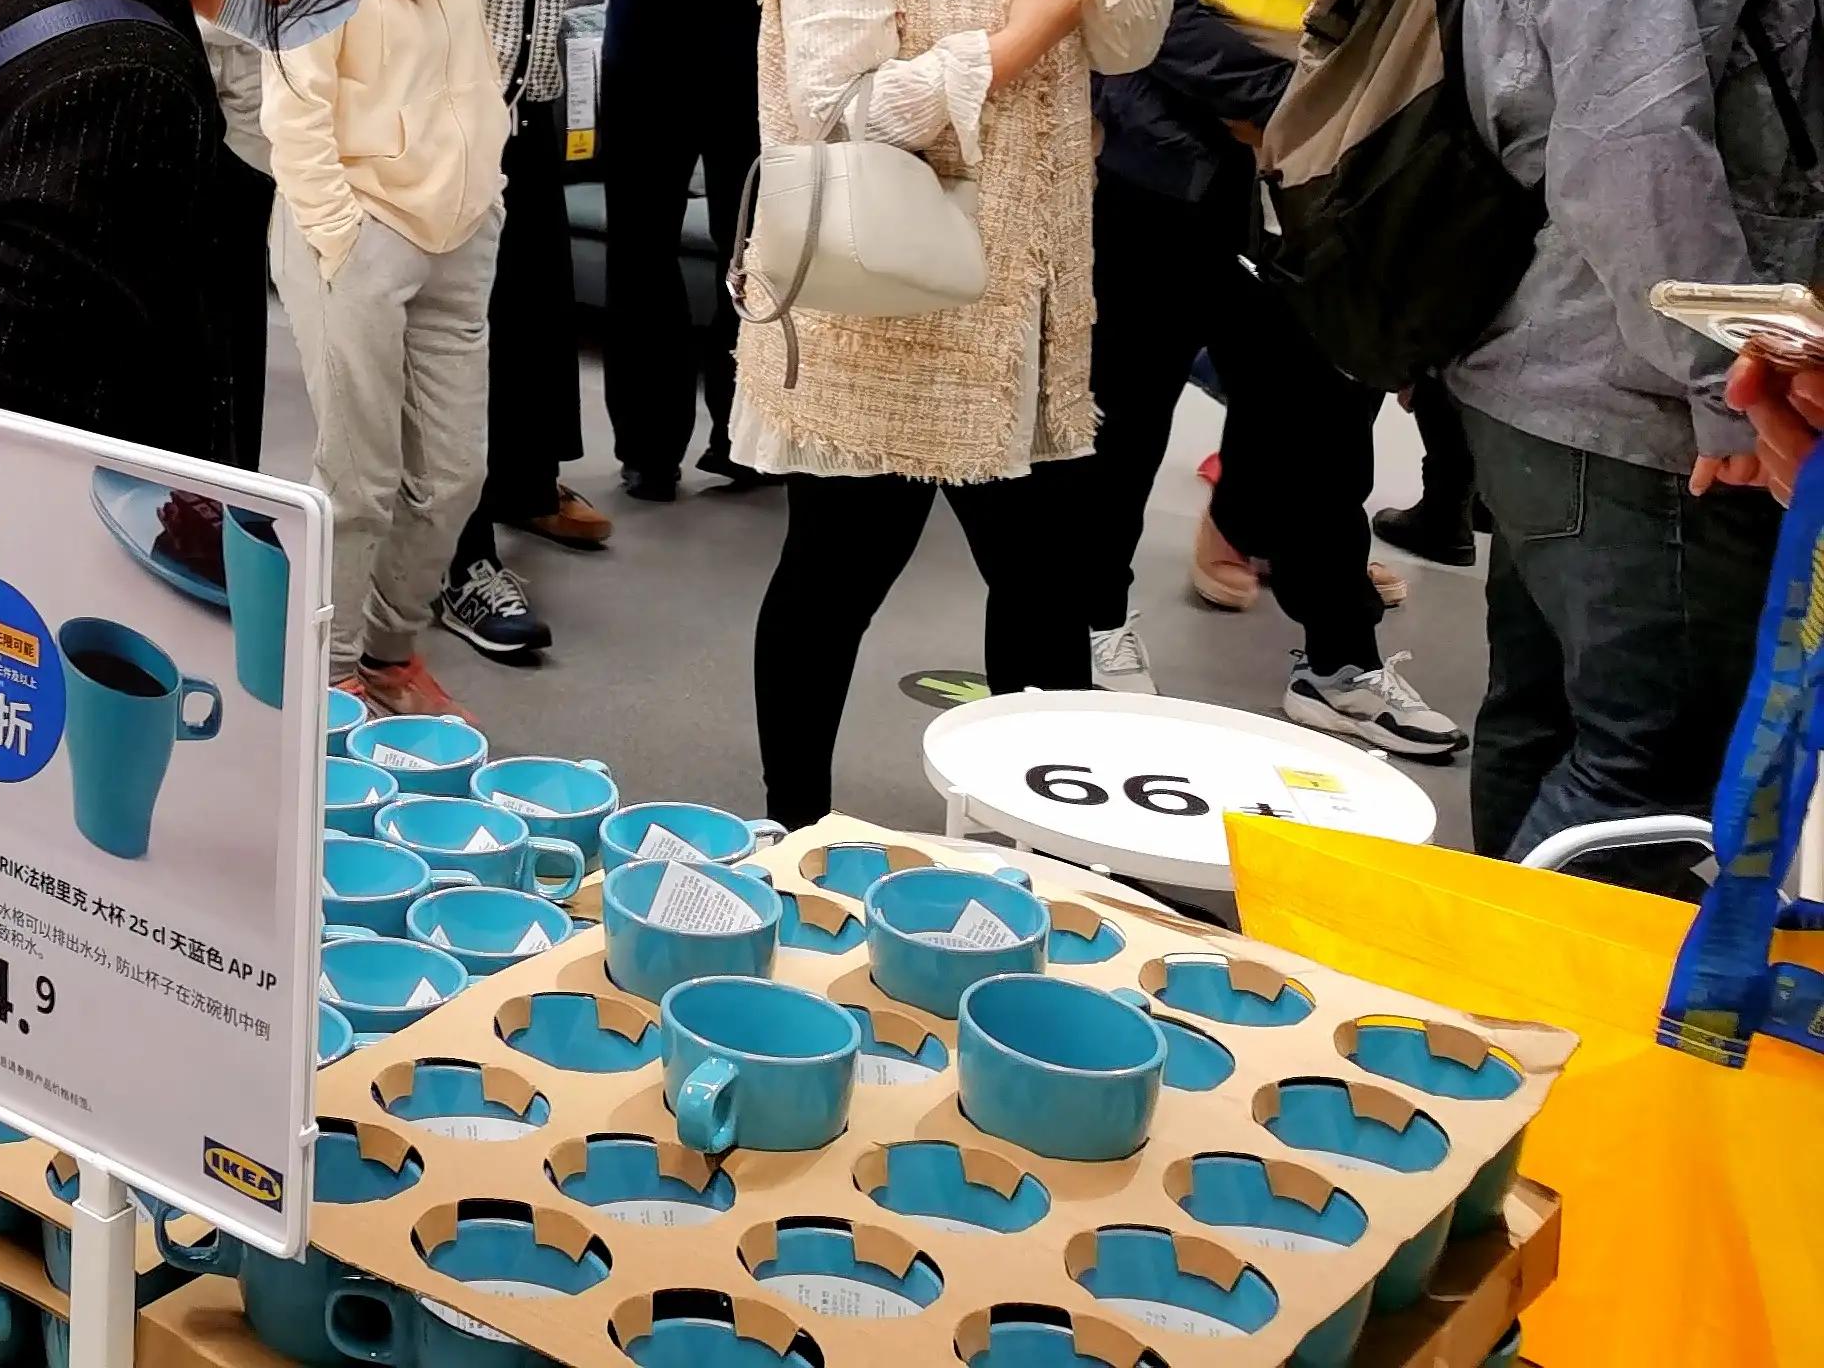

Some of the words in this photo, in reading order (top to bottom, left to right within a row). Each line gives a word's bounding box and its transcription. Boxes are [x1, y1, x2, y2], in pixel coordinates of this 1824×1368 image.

[91, 896, 126, 928] 大杯
[129, 915, 149, 937] 25
[152, 926, 166, 945] cl
[170, 930, 224, 973] 天蓝色
[228, 958, 253, 980] AP
[256, 969, 277, 991] JP
[211, 1150, 278, 1199] IKEA
